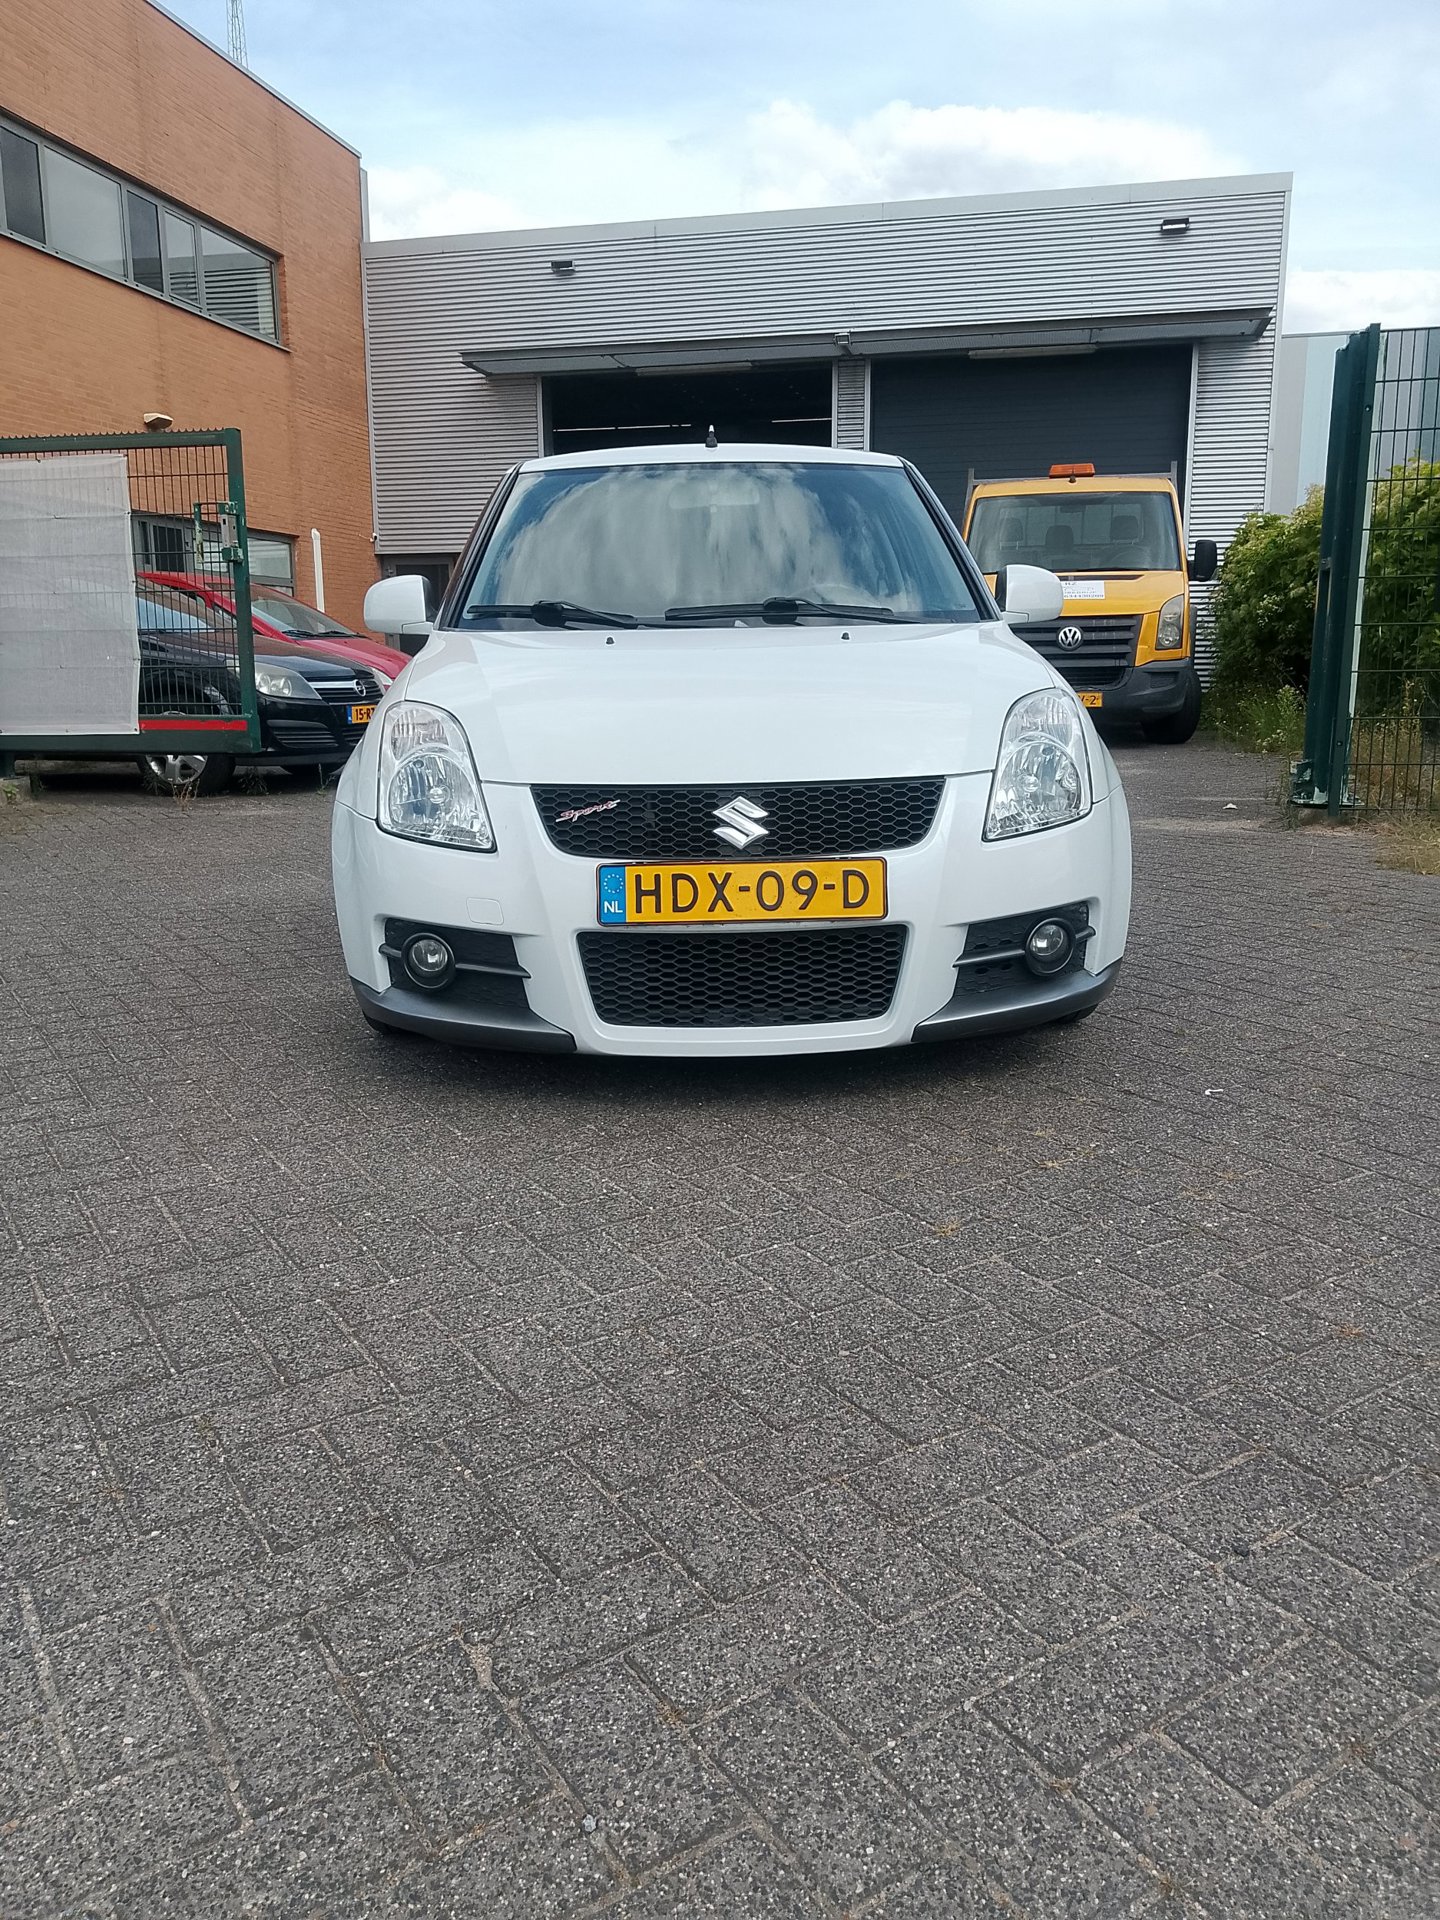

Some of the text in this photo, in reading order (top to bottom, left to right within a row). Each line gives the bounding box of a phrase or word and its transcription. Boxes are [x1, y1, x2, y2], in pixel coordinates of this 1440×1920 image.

[555, 799, 621, 823] Sport
[634, 869, 870, 914] HDX-09-D
[603, 900, 624, 914] NL
